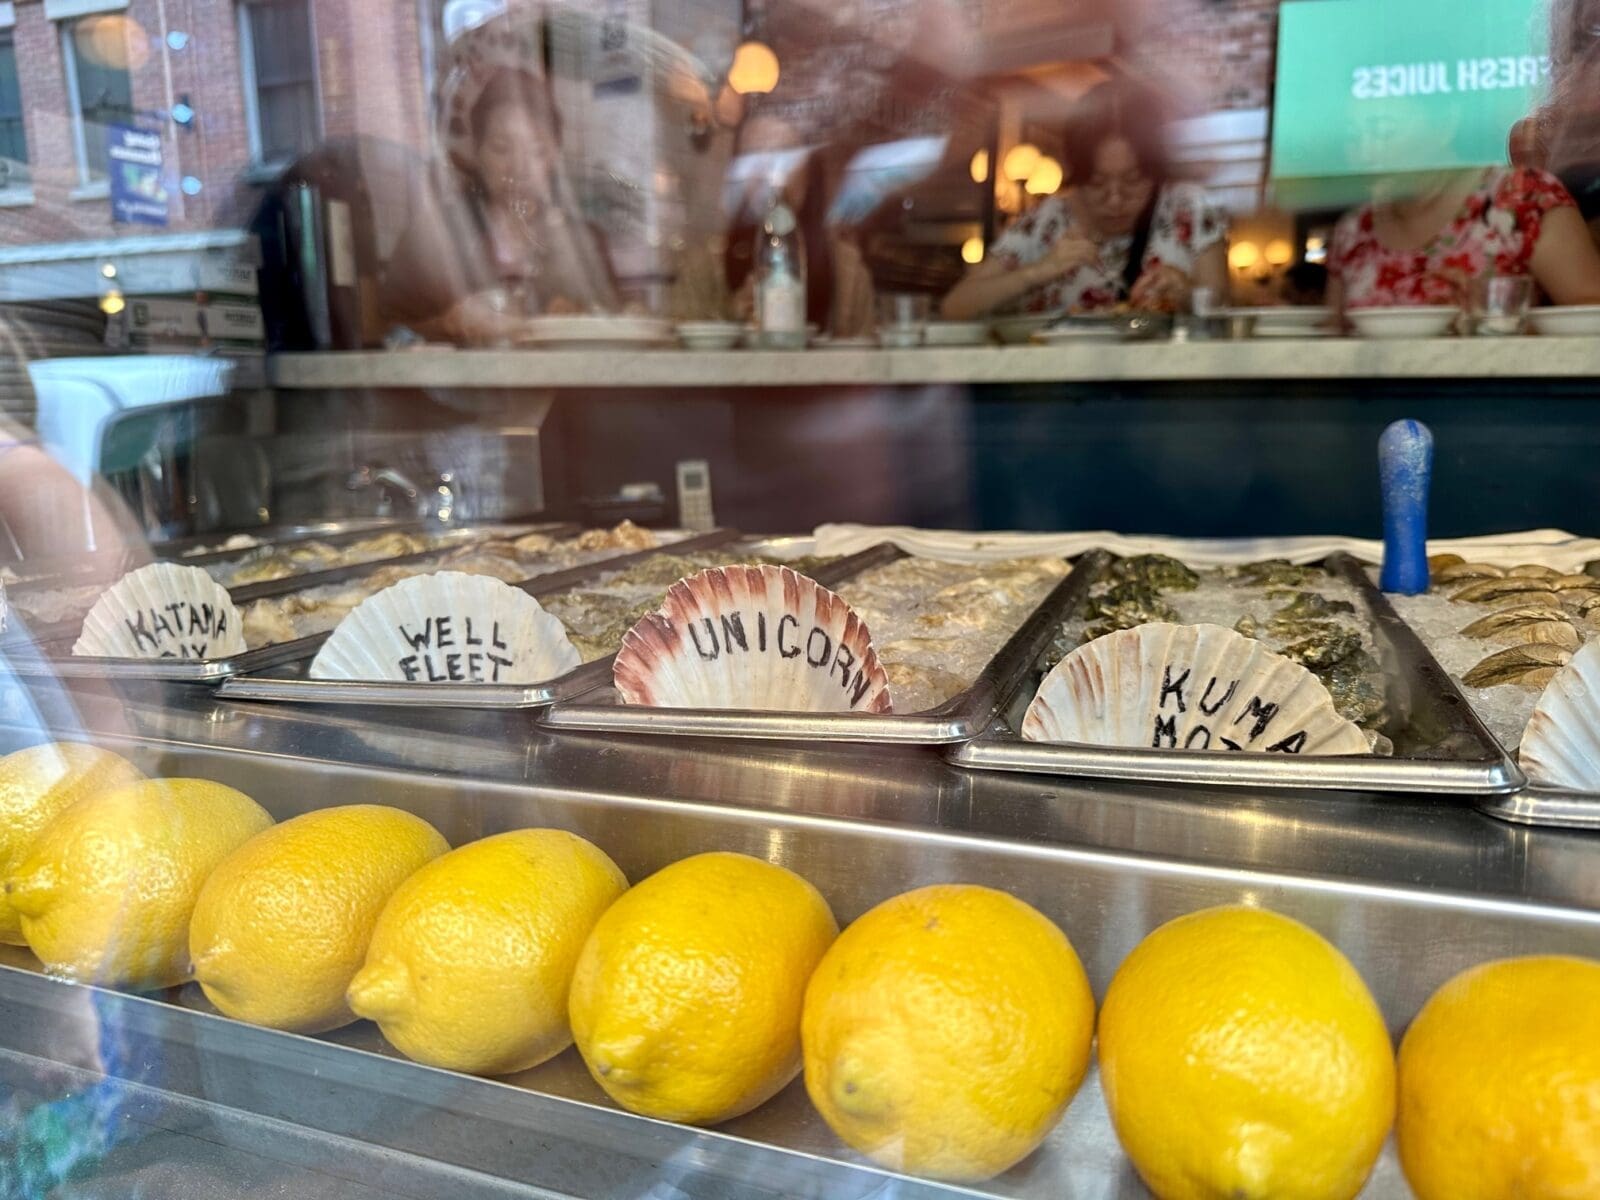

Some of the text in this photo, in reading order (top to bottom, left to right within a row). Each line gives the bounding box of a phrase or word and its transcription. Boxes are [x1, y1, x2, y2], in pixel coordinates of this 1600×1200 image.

[125, 602, 227, 652] KATAMA
[399, 616, 507, 652] WELL
[398, 652, 513, 682] FLEET
[688, 610, 871, 709] UNICORN
[1159, 665, 1307, 754] KUMA
